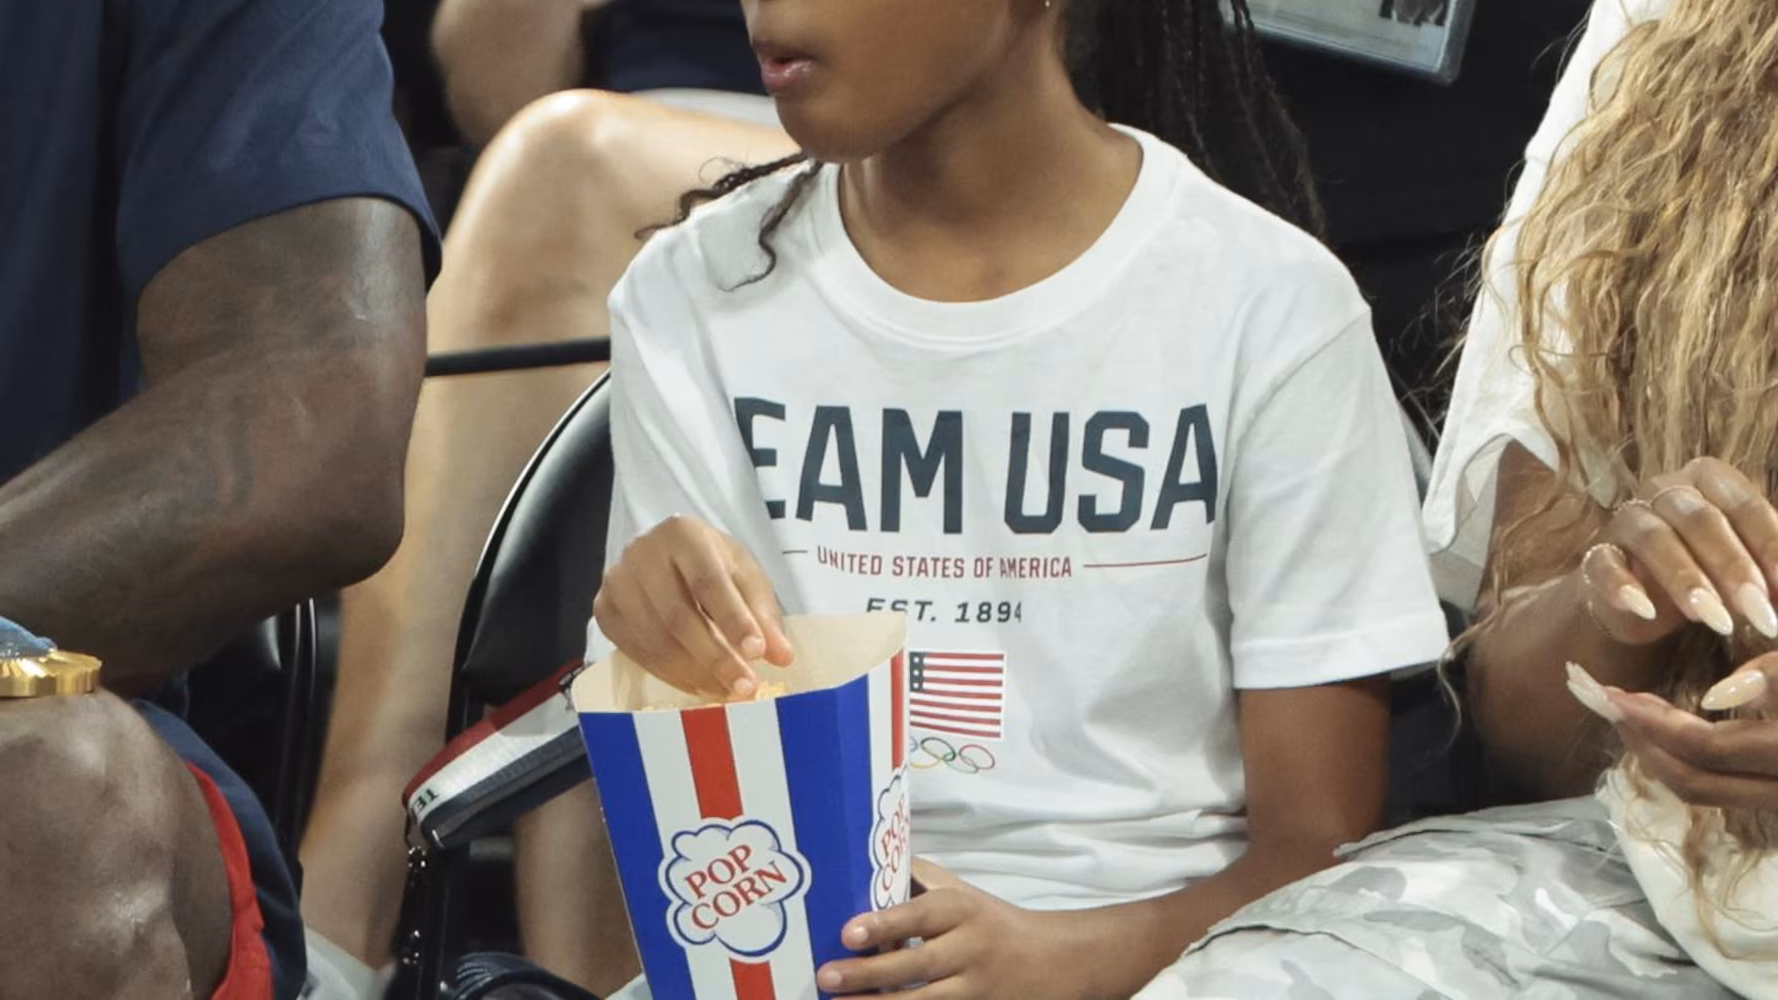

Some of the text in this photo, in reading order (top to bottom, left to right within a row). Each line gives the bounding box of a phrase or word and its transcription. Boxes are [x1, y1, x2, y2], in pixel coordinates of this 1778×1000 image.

[734, 396, 1219, 535] EAM USA
[817, 544, 1072, 580] UNITED STATES OF AMERICA
[866, 597, 938, 623] EST.
[684, 844, 753, 900] POP
[691, 860, 788, 930] CORN
